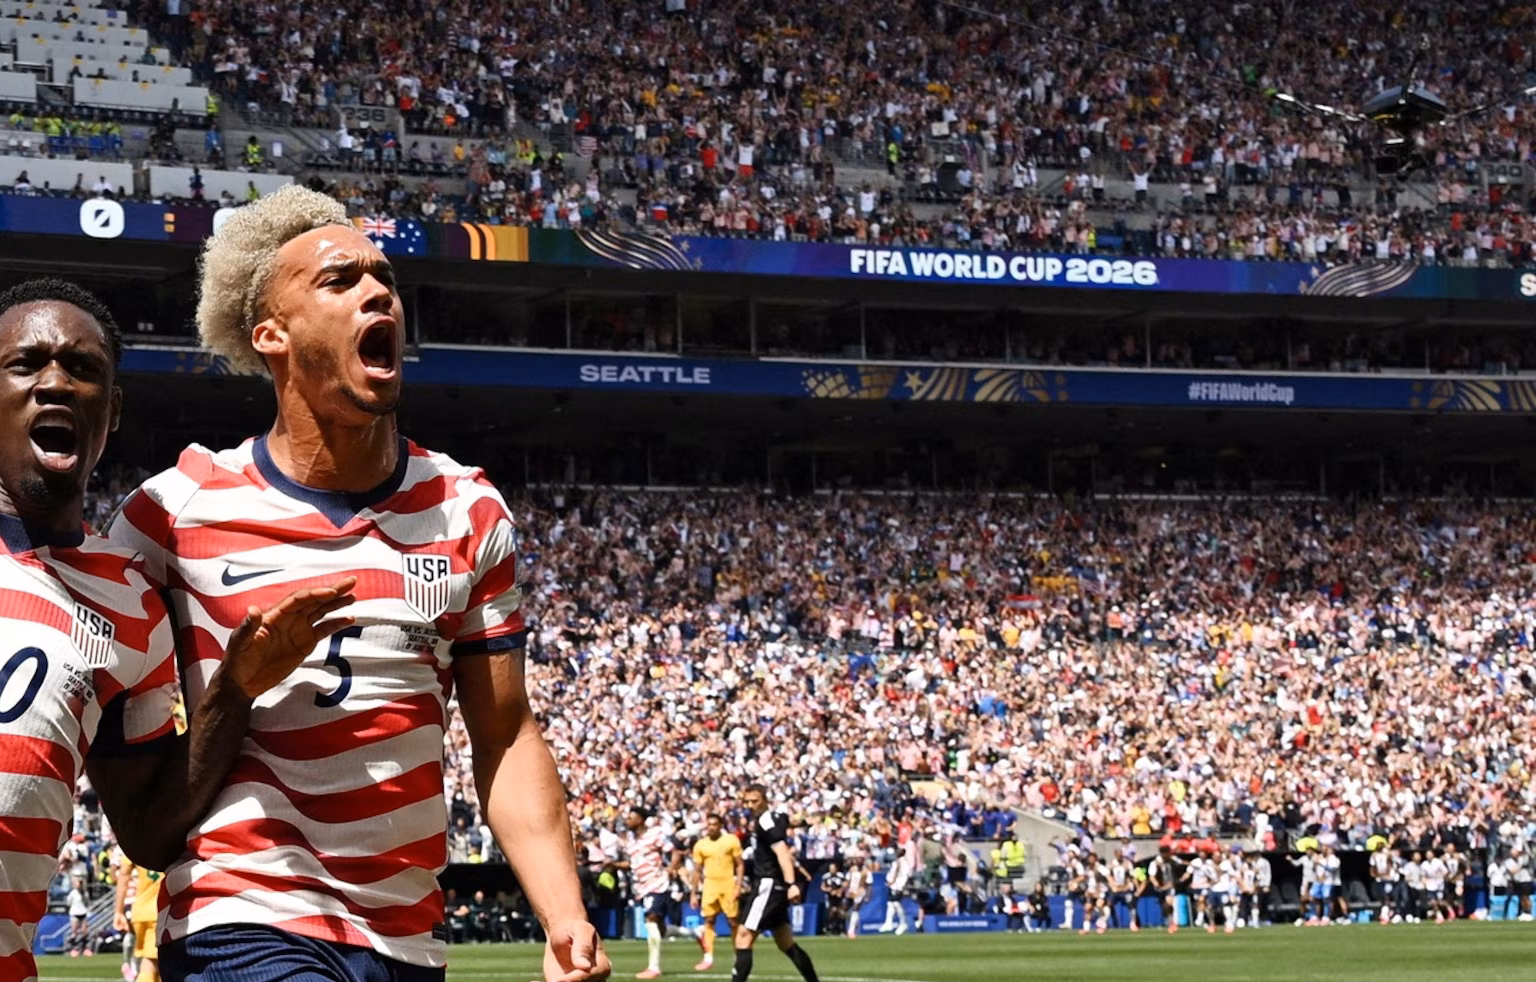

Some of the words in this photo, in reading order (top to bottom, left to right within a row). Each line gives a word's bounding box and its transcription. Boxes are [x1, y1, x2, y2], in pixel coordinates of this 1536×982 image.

[850, 249, 907, 275] FIFA
[910, 252, 1006, 280] WORLD
[1009, 256, 1062, 281] CUP
[1065, 258, 1158, 286] 2026
[579, 364, 711, 385] SEATTLE
[1188, 382, 1295, 406] #FIFAWorldCup
[407, 557, 448, 583] USA
[75, 605, 113, 640] USA
[314, 625, 364, 708] 5
